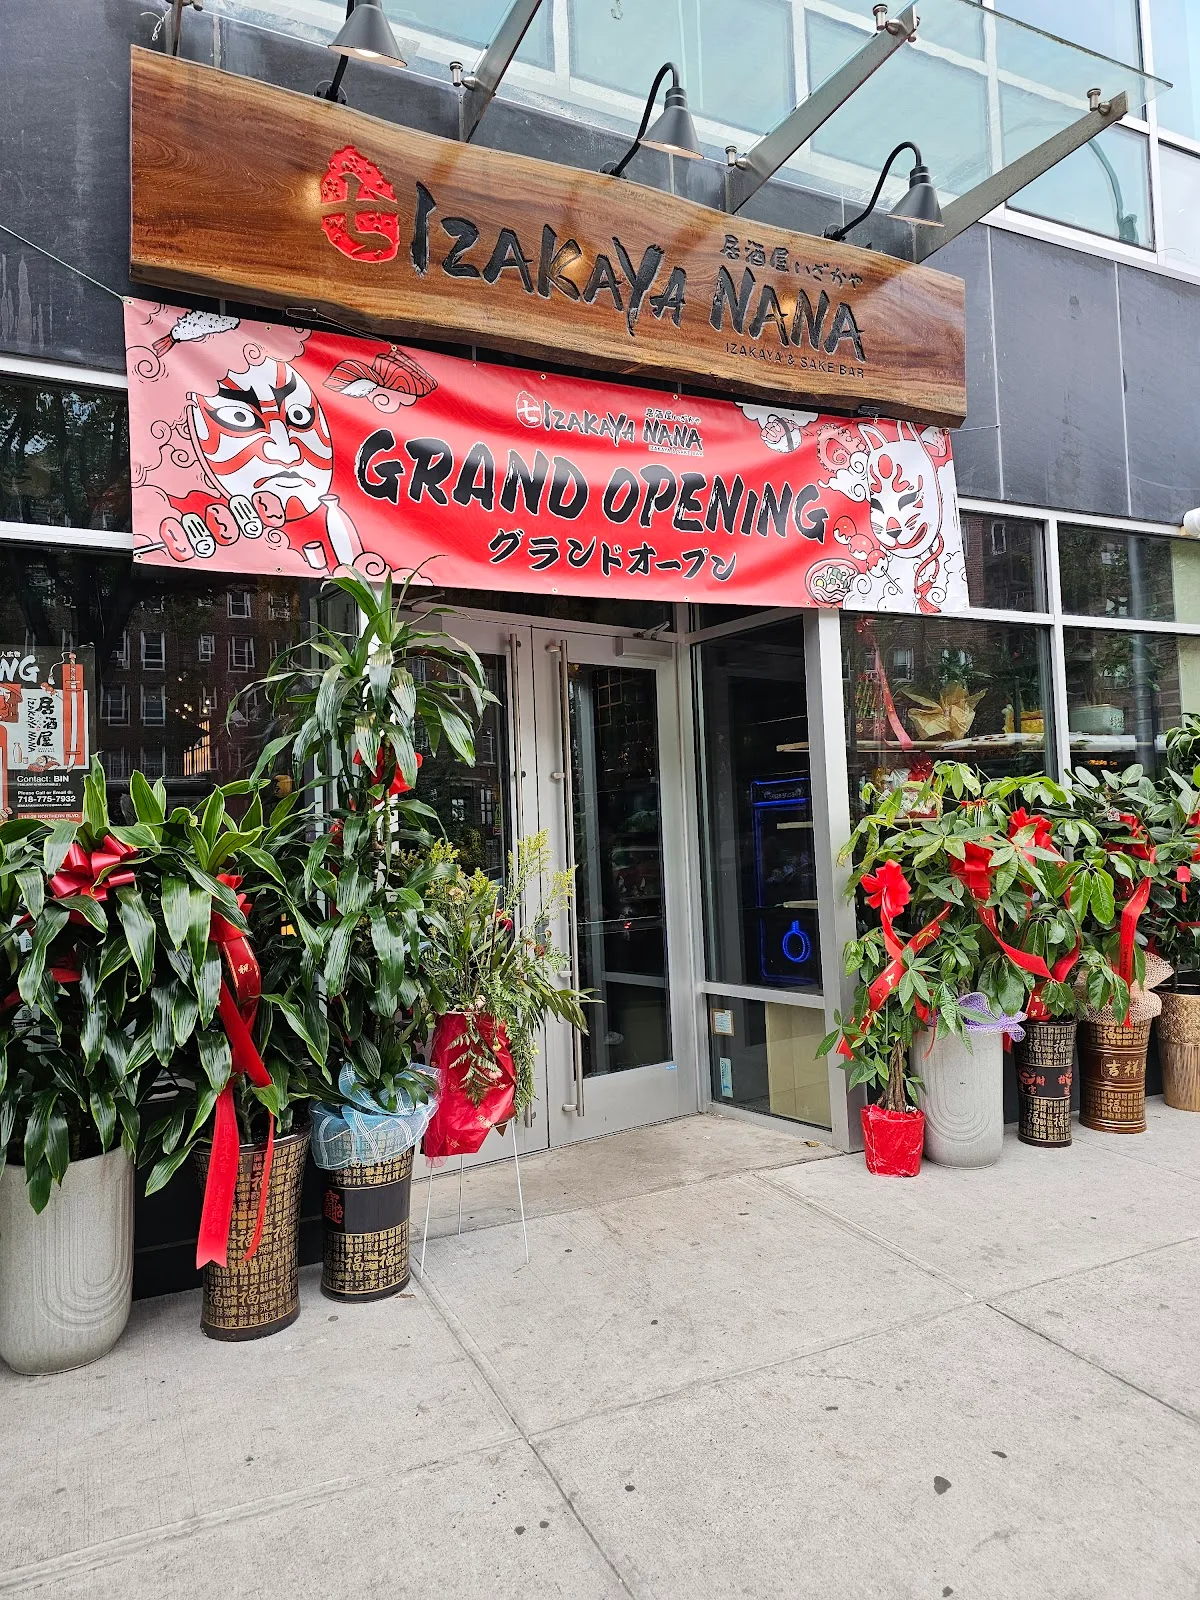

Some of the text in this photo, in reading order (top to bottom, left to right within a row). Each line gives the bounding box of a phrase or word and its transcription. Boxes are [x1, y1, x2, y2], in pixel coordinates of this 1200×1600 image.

[411, 181, 867, 364] IZAKAYA NANA
[726, 342, 865, 379] IZAKAYA & SAKE BAR
[543, 400, 704, 451] IZAKAYA NANA
[354, 428, 828, 544] GRAND OPENING
[488, 528, 738, 582] グランドオープン
[27, 698, 37, 753] IZAKAYA NANA
[35, 697, 57, 747] 居酒屋
[1105, 1059, 1147, 1078] 吉祥
[345, 1253, 364, 1272] 福
[238, 1284, 260, 1305] 福
